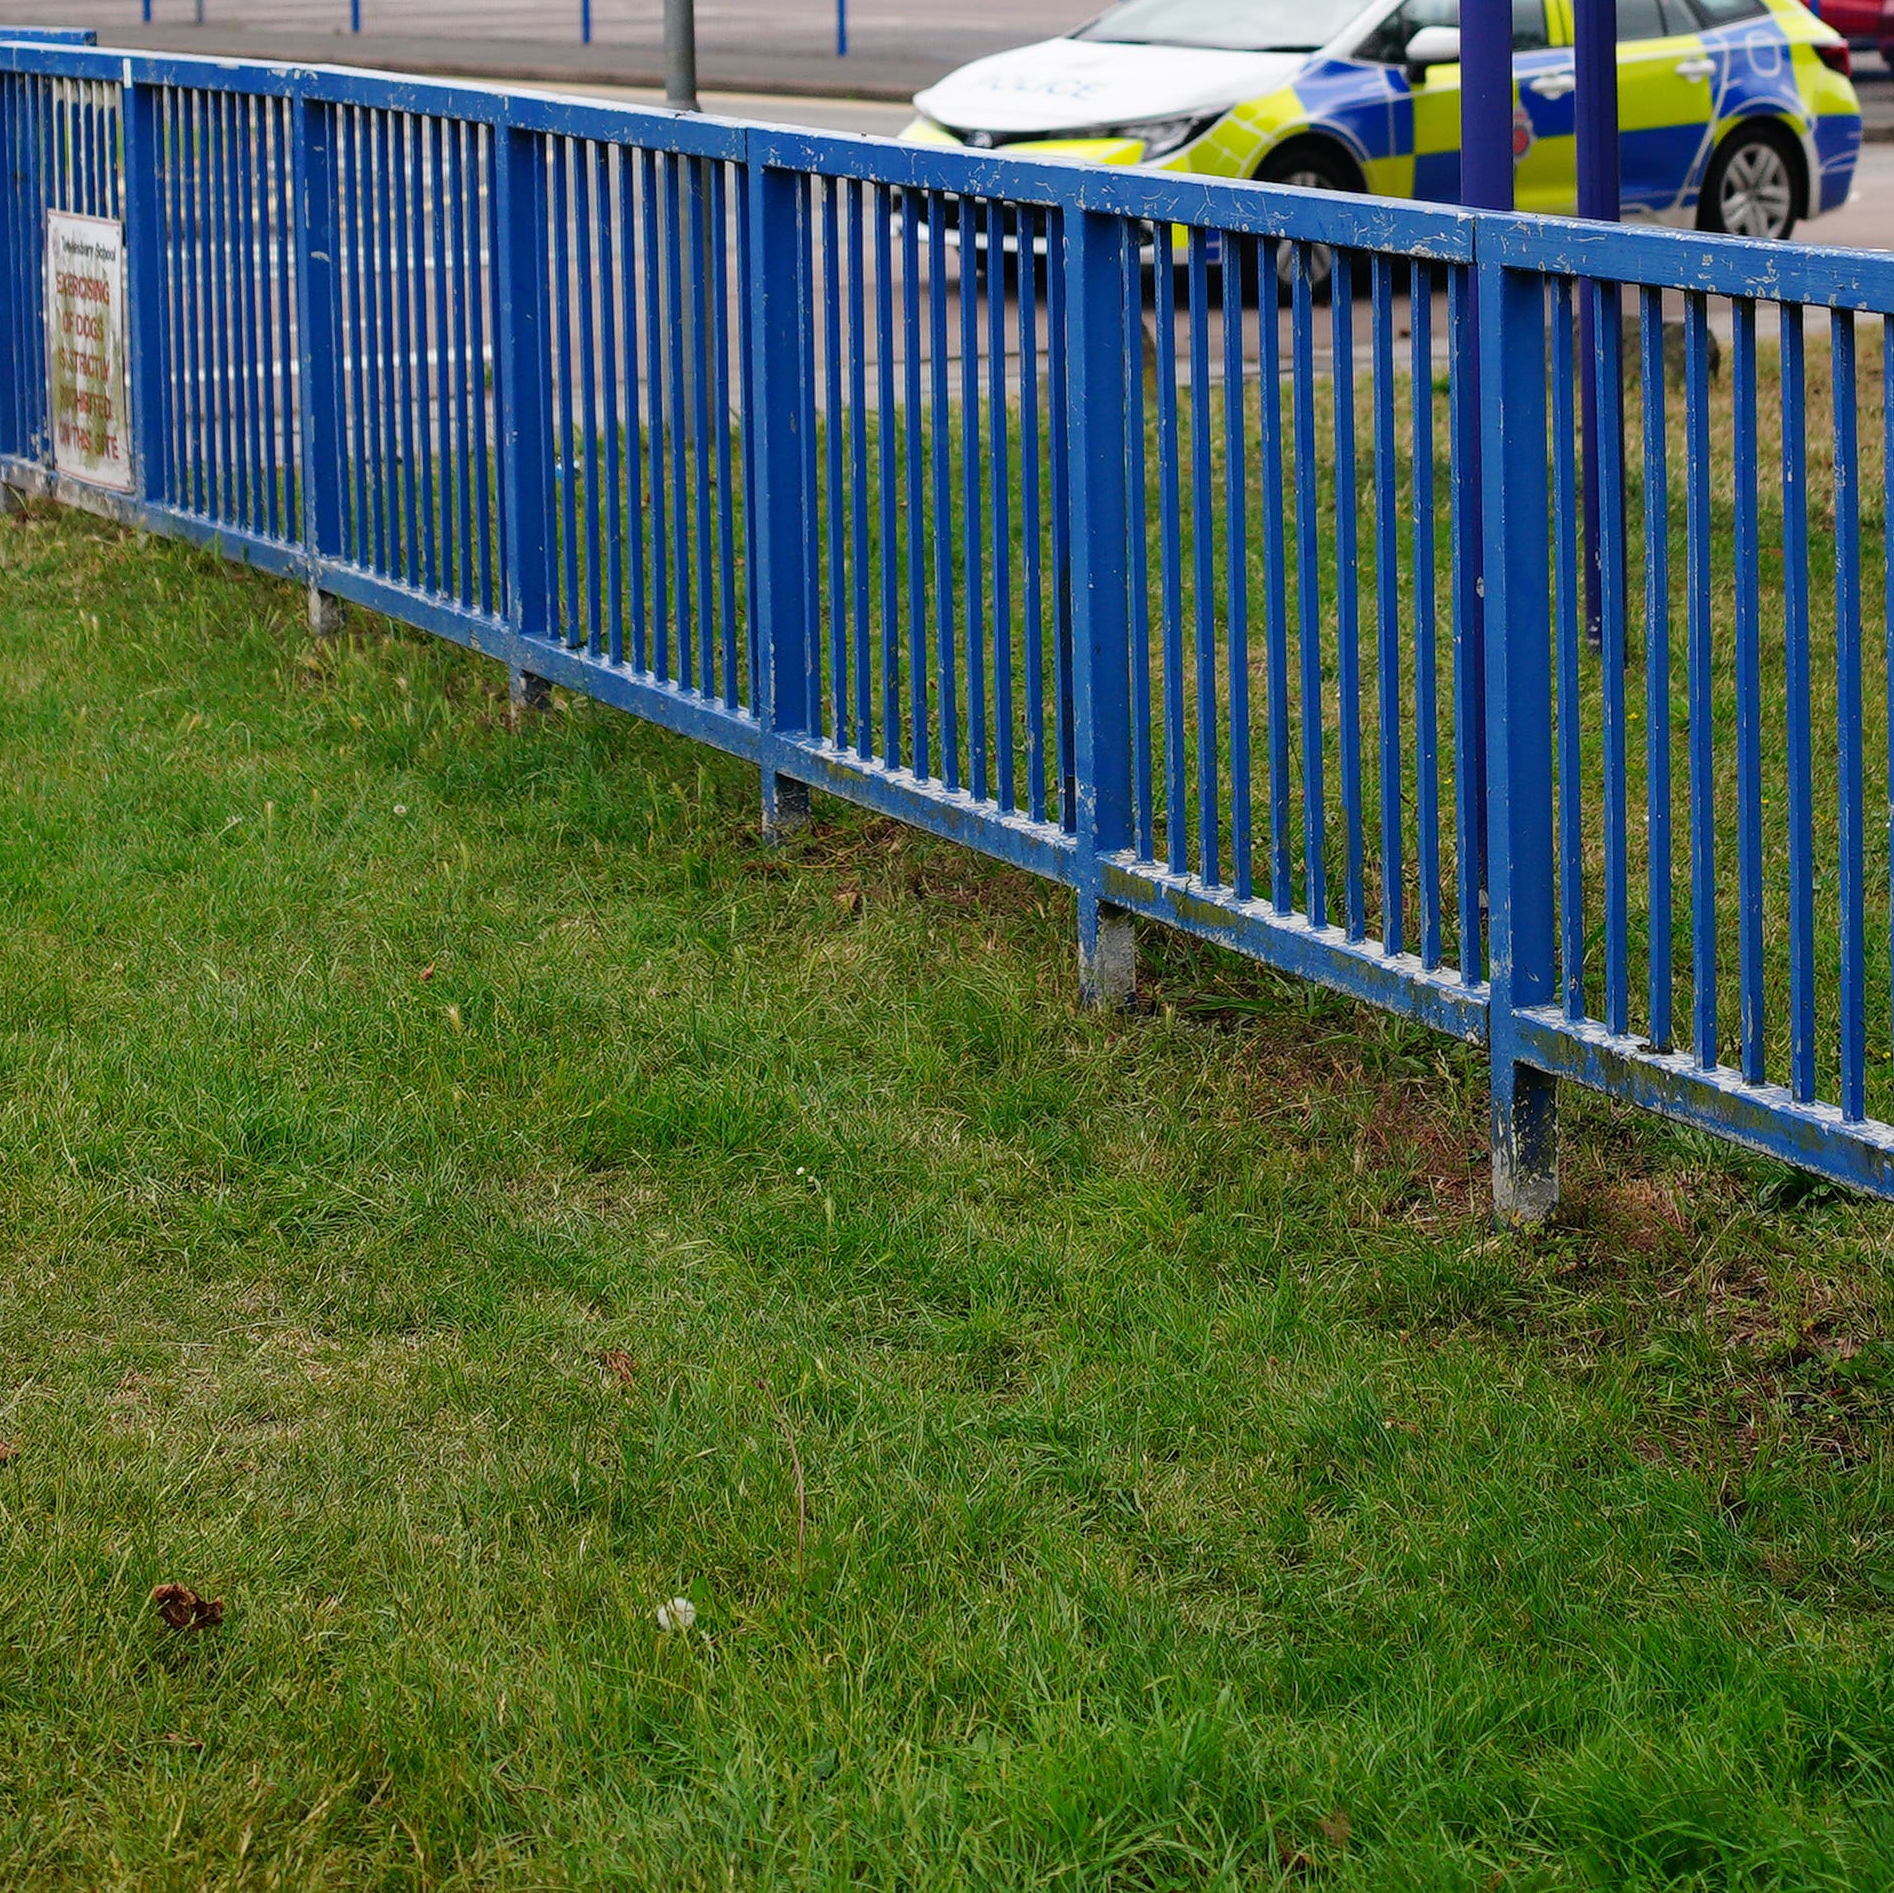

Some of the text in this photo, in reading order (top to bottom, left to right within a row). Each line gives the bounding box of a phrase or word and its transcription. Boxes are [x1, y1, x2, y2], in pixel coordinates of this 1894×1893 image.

[95, 241, 116, 262] School
[56, 271, 110, 306] EXERCISING
[76, 314, 104, 342] DOGS
